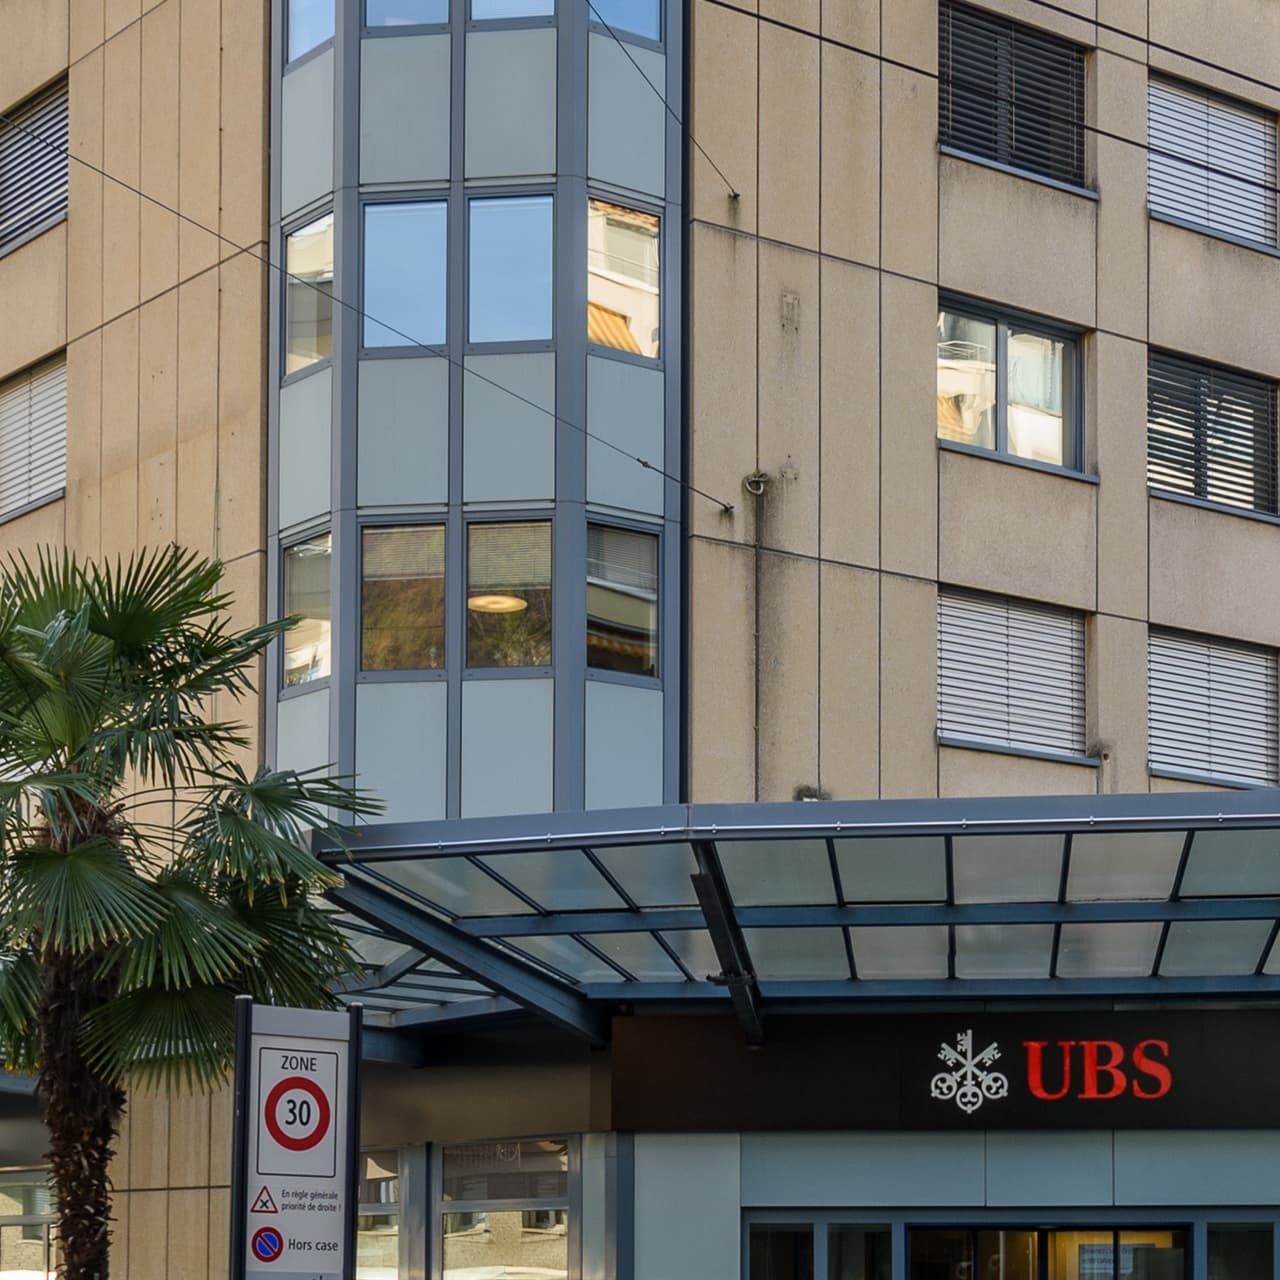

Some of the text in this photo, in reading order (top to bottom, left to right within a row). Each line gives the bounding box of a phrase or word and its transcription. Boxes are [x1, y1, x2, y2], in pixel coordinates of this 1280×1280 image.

[281, 1055, 317, 1072] ZONE
[1022, 1039, 1173, 1100] UBS
[285, 1099, 311, 1126] 30
[281, 1189, 338, 1201] En règle générale
[281, 1202, 306, 1211] priorité
[307, 1202, 315, 1211] de
[317, 1203, 337, 1212] droite
[288, 1238, 338, 1251] Hors case
